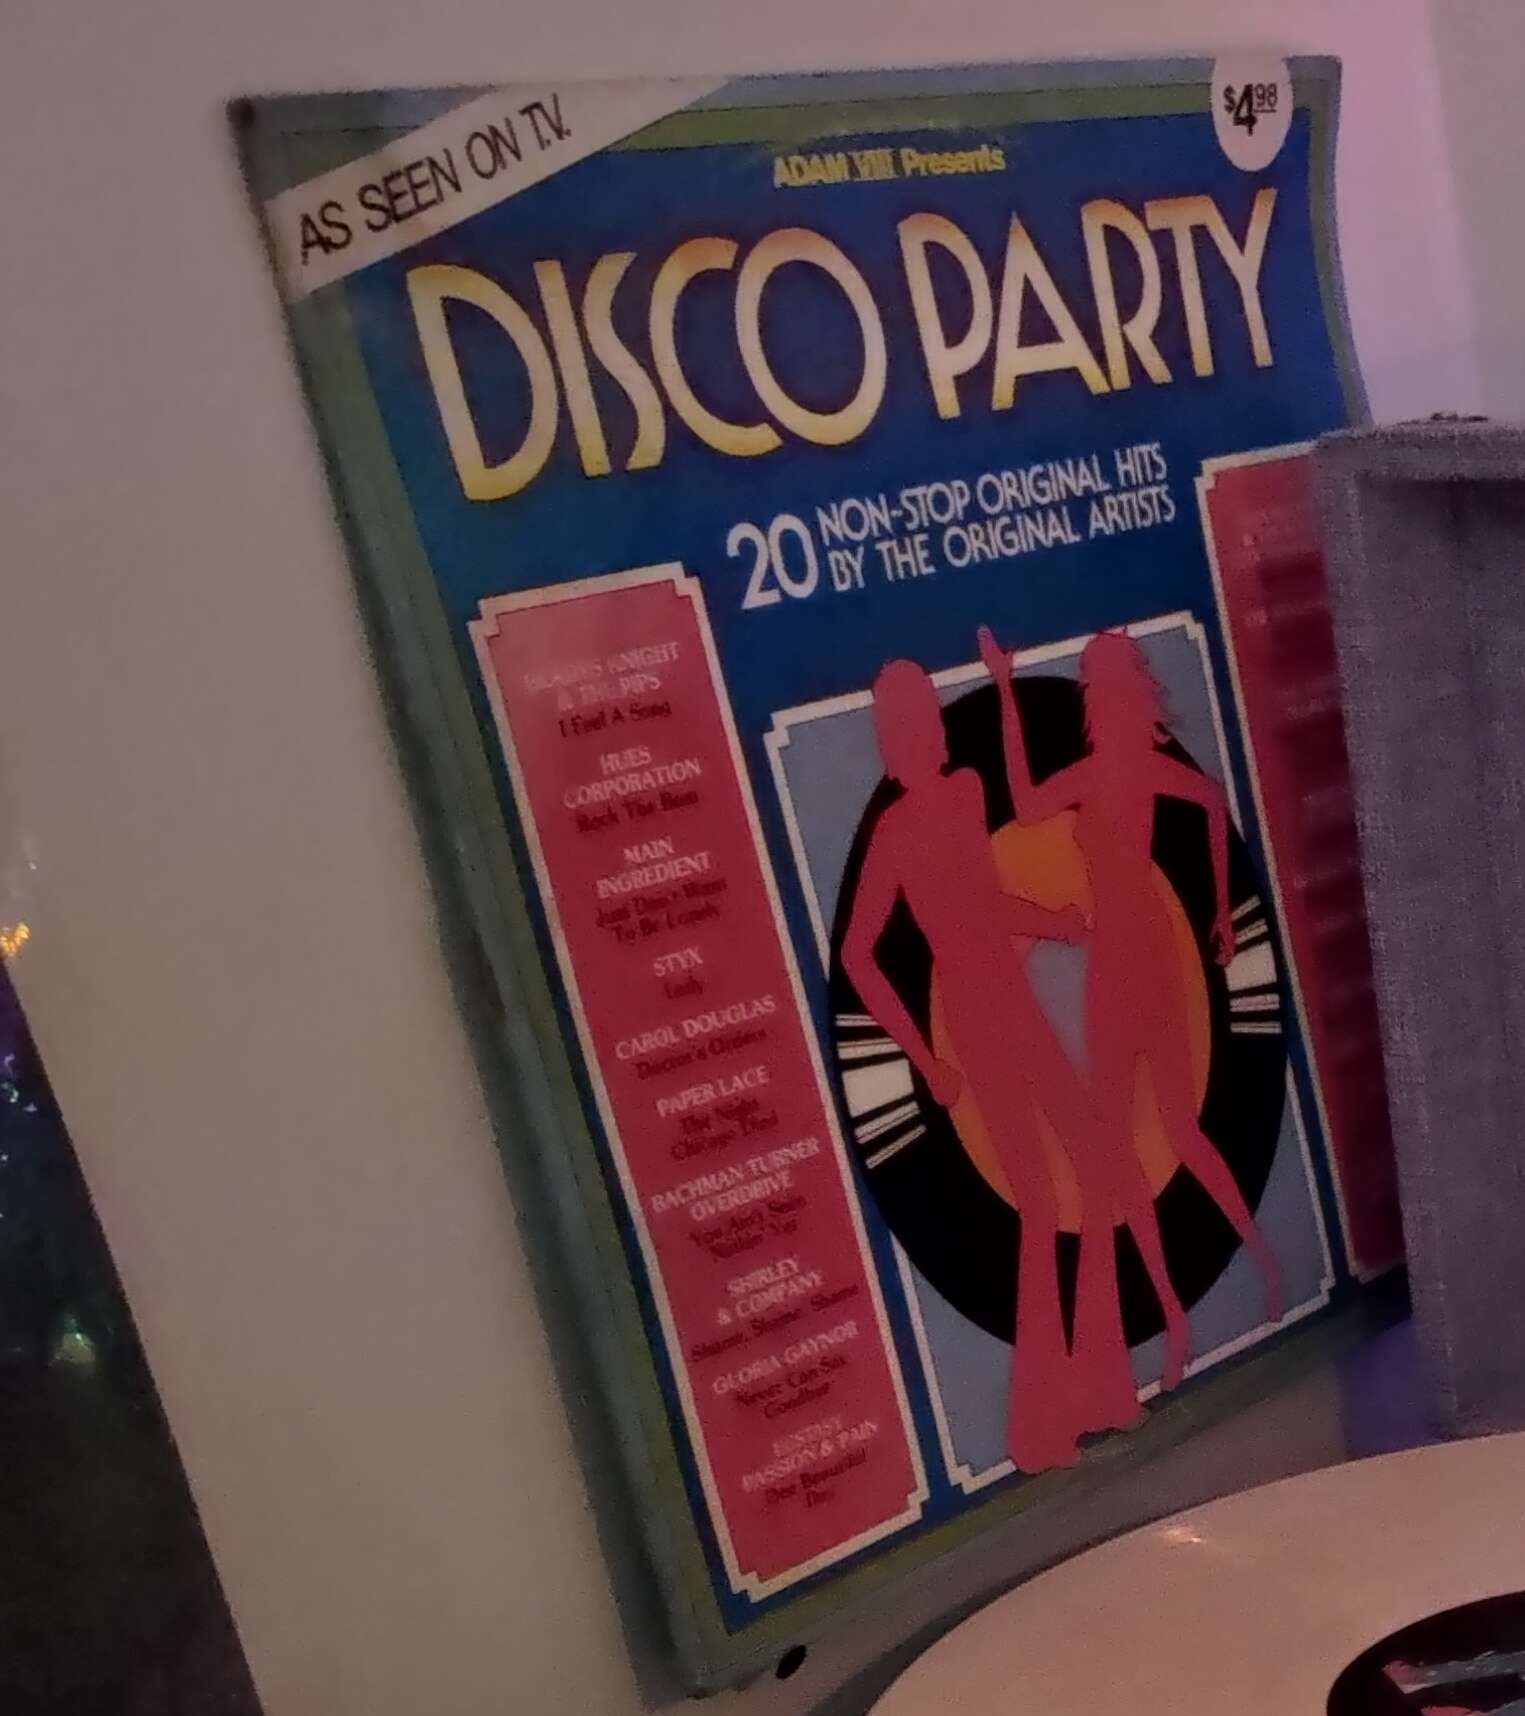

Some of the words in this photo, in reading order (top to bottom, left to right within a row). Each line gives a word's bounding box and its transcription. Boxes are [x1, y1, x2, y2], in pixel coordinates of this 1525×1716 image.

[300, 201, 353, 265] AS
[357, 148, 462, 232] SEEN
[465, 117, 522, 179] ON
[774, 149, 848, 188] ADAM
[901, 143, 1006, 180] Presents
[405, 225, 888, 503] DISCO
[896, 186, 1277, 420] PARTY
[816, 479, 970, 547] NON-STOP
[976, 453, 1110, 515] ORIGINAL
[1113, 441, 1167, 487] HITS
[727, 513, 819, 610] 20
[828, 545, 865, 592] BY
[876, 534, 936, 582] THE
[943, 511, 1082, 569] ORIGINAL
[1088, 484, 1176, 540] ARTISTS
[563, 756, 703, 810] CORPORATION
[597, 850, 713, 899] INGREDIENT
[623, 835, 675, 864] MAIN
[653, 946, 704, 977] STYX
[615, 1022, 678, 1060] CAROL
[681, 994, 776, 1037] DOUGLAS
[655, 1079, 720, 1118] PAPER
[719, 1065, 771, 1096] LACE
[689, 1169, 794, 1221] OVERDRIVE
